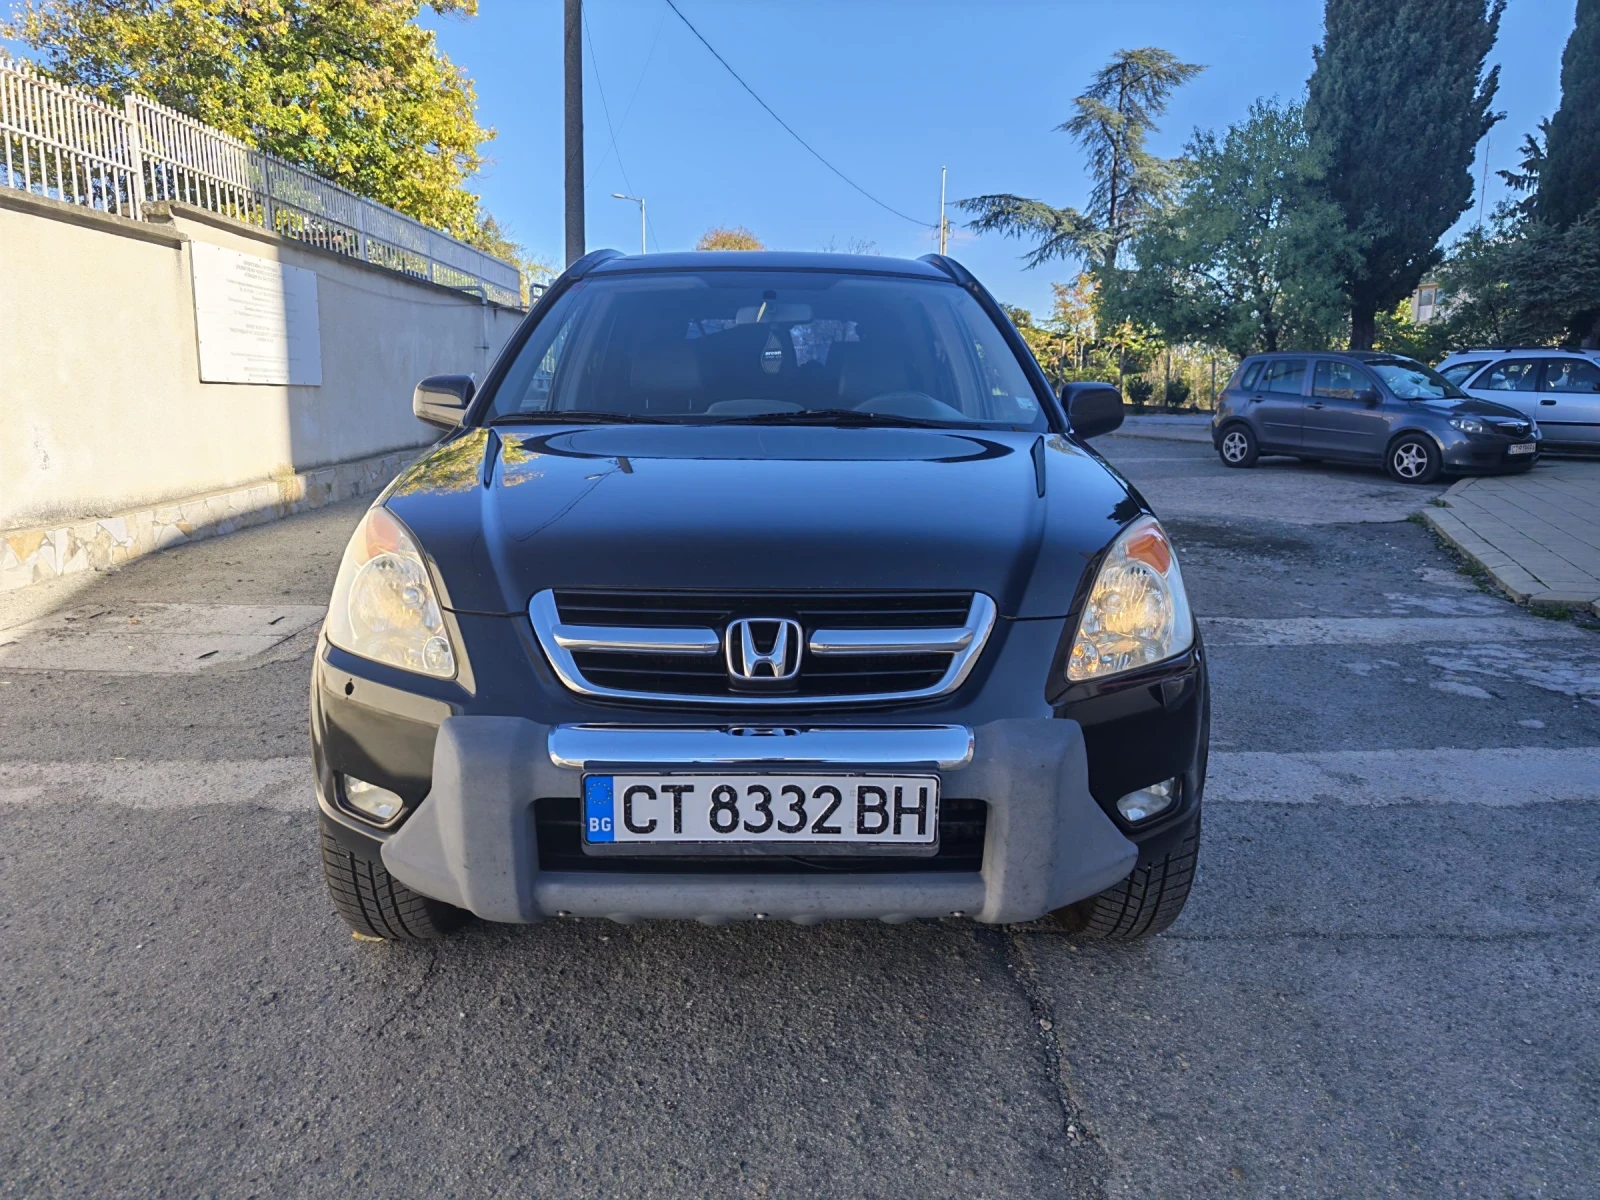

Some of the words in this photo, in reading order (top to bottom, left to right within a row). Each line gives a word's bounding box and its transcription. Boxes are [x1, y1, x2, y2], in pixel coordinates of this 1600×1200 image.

[589, 817, 612, 832] BG
[623, 784, 695, 834] CT
[708, 784, 843, 835] 8332
[856, 785, 927, 836] BH
